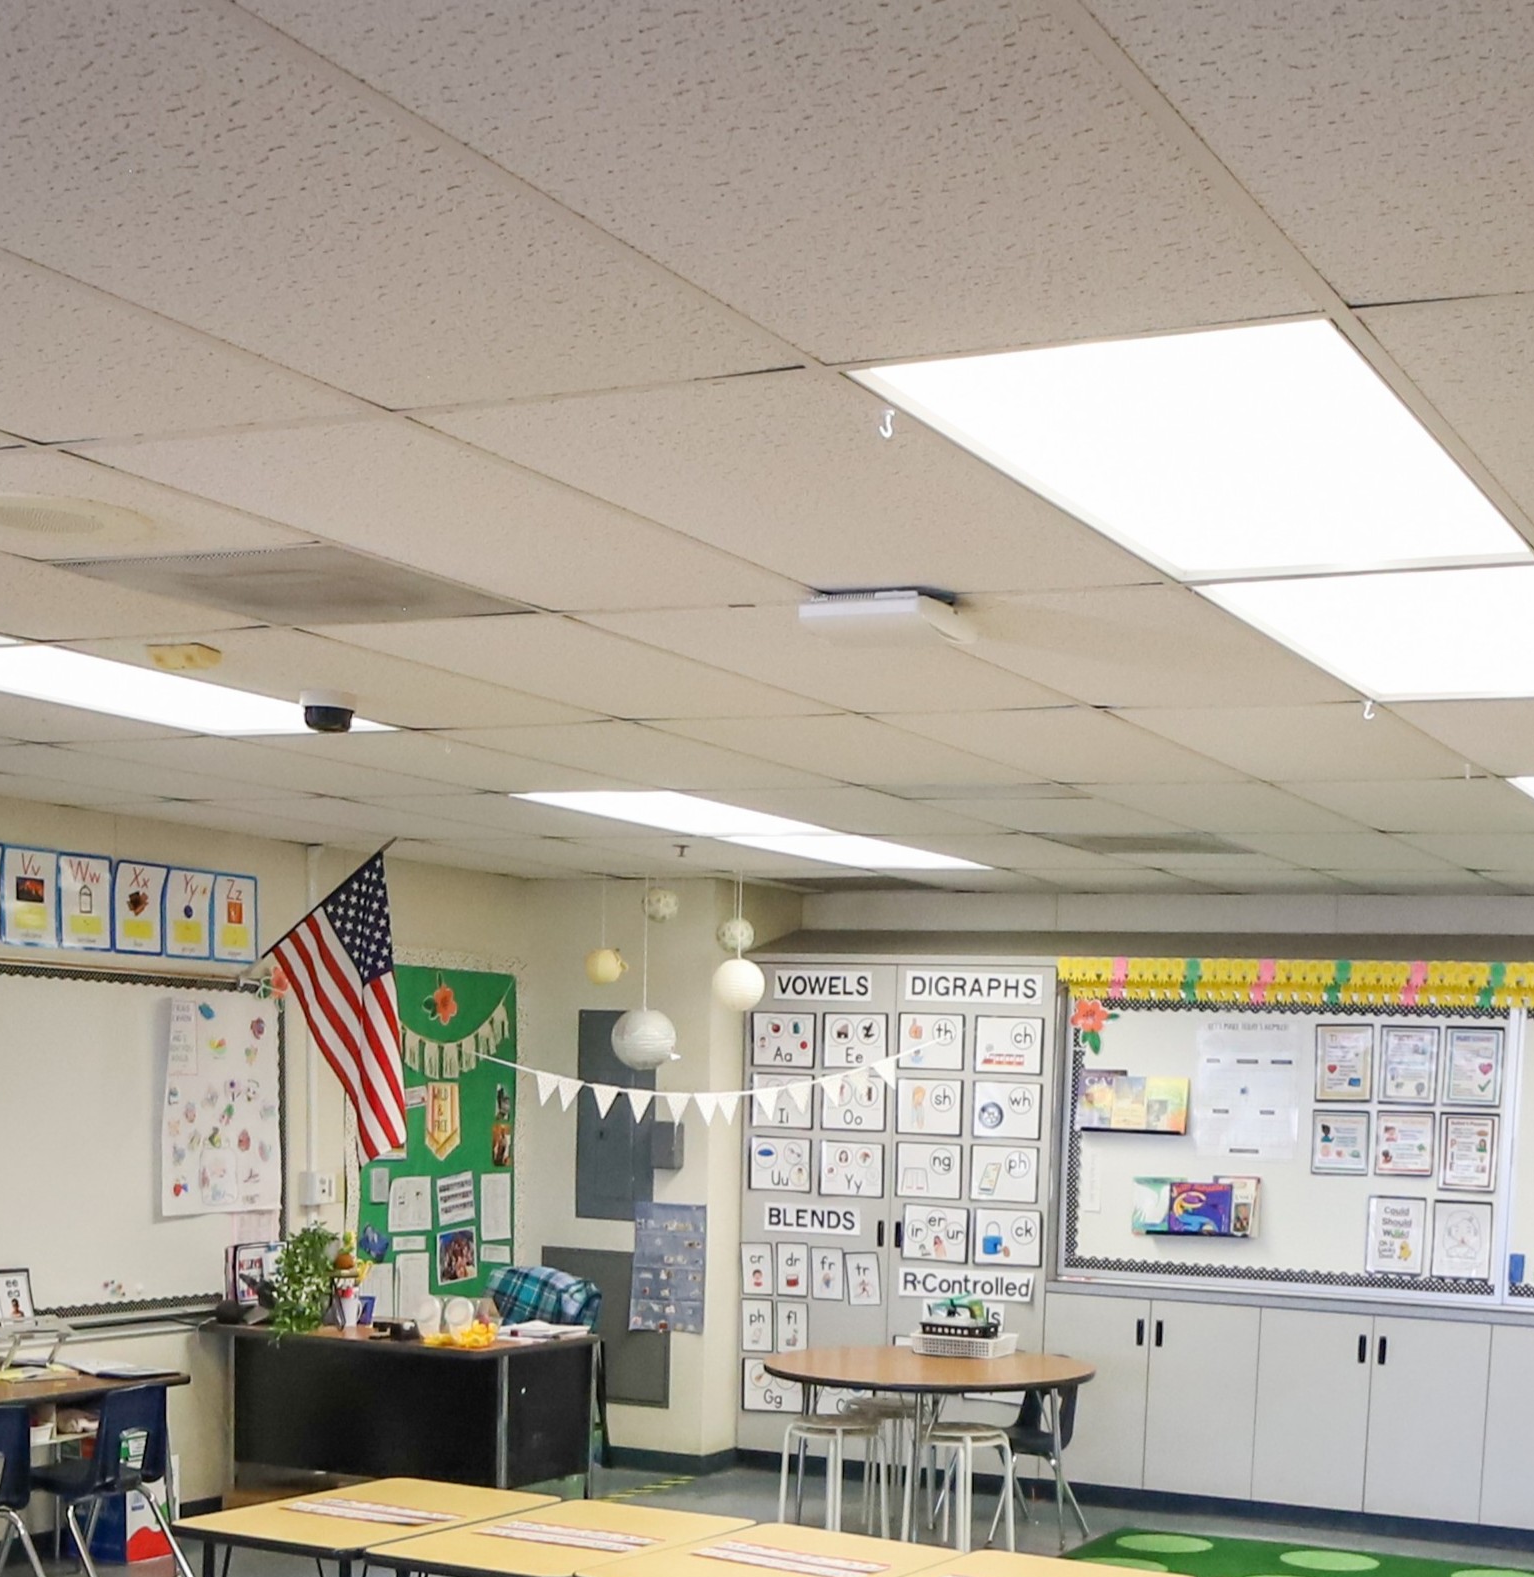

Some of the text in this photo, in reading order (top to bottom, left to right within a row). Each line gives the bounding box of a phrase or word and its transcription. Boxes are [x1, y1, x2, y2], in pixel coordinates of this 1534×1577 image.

[20, 853, 42, 878] Vv
[68, 858, 101, 885] Ww
[129, 866, 151, 891] Xx
[183, 873, 199, 902] Yy
[226, 879, 243, 901] Zz
[776, 974, 870, 997] VOWELS
[910, 975, 1039, 1000] DIGRAPHS
[935, 1021, 954, 1040] th
[1013, 1027, 1034, 1044] ch
[772, 1041, 794, 1064] Aa
[844, 1047, 864, 1065] Ee
[932, 1089, 953, 1106] sh
[1008, 1090, 1033, 1109] wh
[842, 1108, 864, 1127] Oo
[931, 1153, 953, 1173] ng
[1007, 1153, 1028, 1175] ph
[770, 1170, 791, 1187] Uu
[843, 1173, 863, 1195] Yy
[766, 1206, 857, 1231] BLENDS
[1383, 1205, 1410, 1217] Could
[910, 1223, 924, 1239] ir
[927, 1214, 947, 1229] er
[1014, 1219, 1035, 1238] ck
[1381, 1217, 1413, 1228] Should
[945, 1226, 965, 1243] ur
[749, 1253, 765, 1265] cr
[784, 1252, 802, 1268] dr
[819, 1256, 837, 1272] fr
[854, 1262, 870, 1277] tr
[5, 1279, 19, 1289] ee
[902, 1272, 1032, 1299] R-Controlled
[748, 1311, 766, 1328] ph
[762, 1388, 784, 1408] Gg
